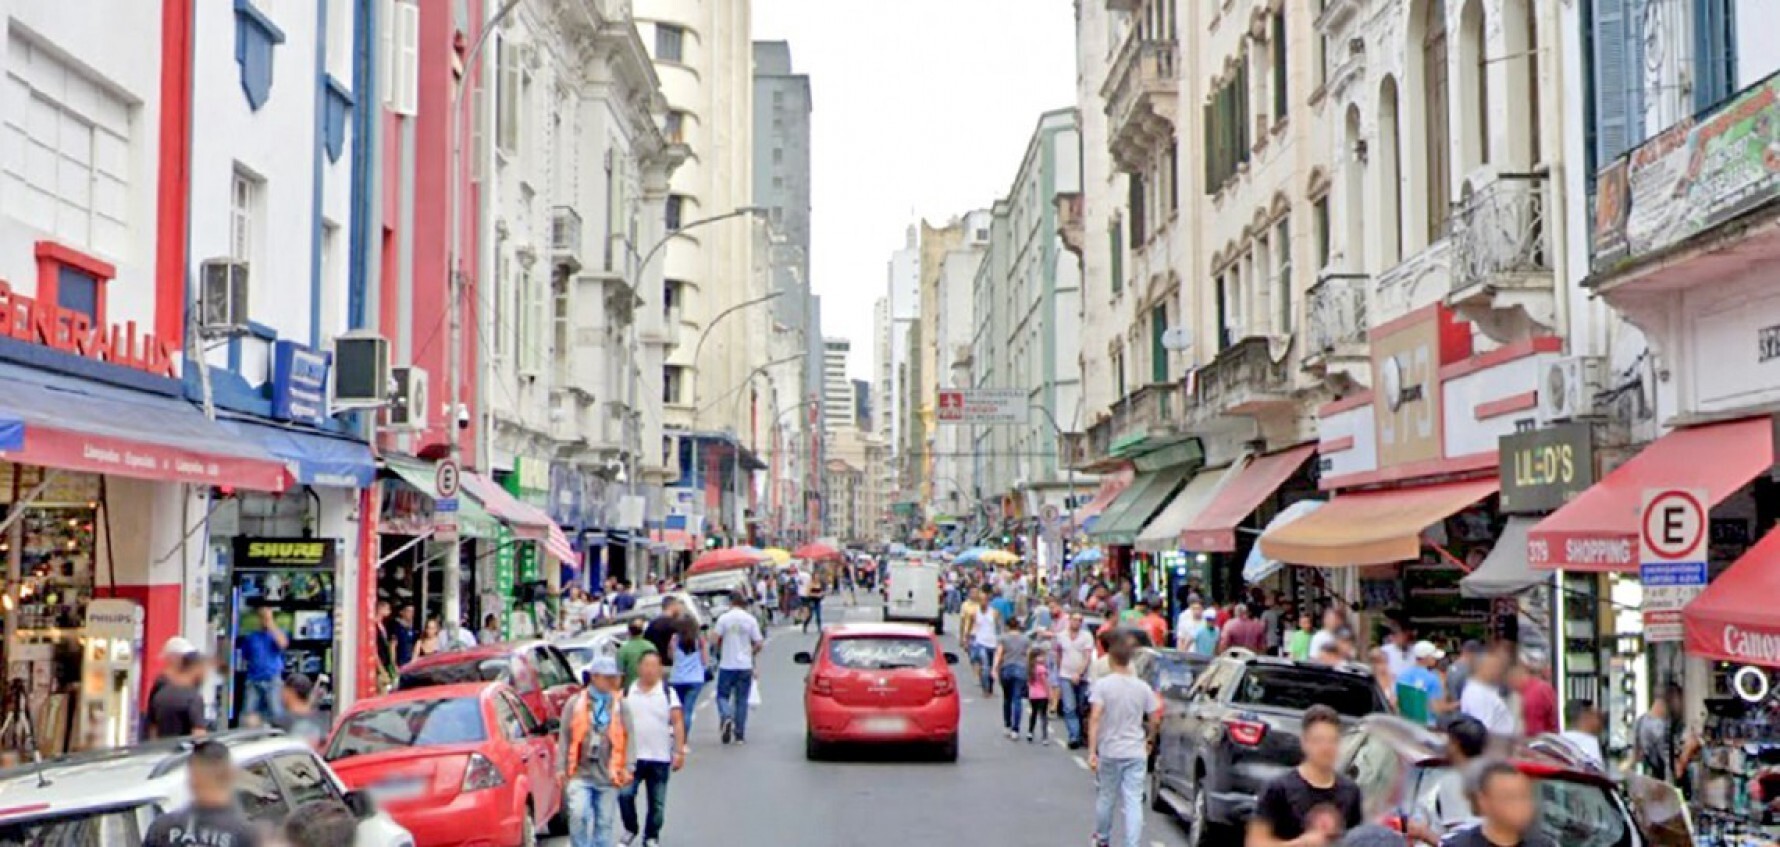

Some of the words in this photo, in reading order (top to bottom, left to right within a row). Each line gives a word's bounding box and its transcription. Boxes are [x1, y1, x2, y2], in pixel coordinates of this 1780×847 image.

[444, 468, 452, 489] E
[1664, 507, 1684, 543] E
[248, 542, 325, 558] SHURE
[1565, 538, 1631, 563] SHOPPING
[91, 612, 132, 623] PHILIPS
